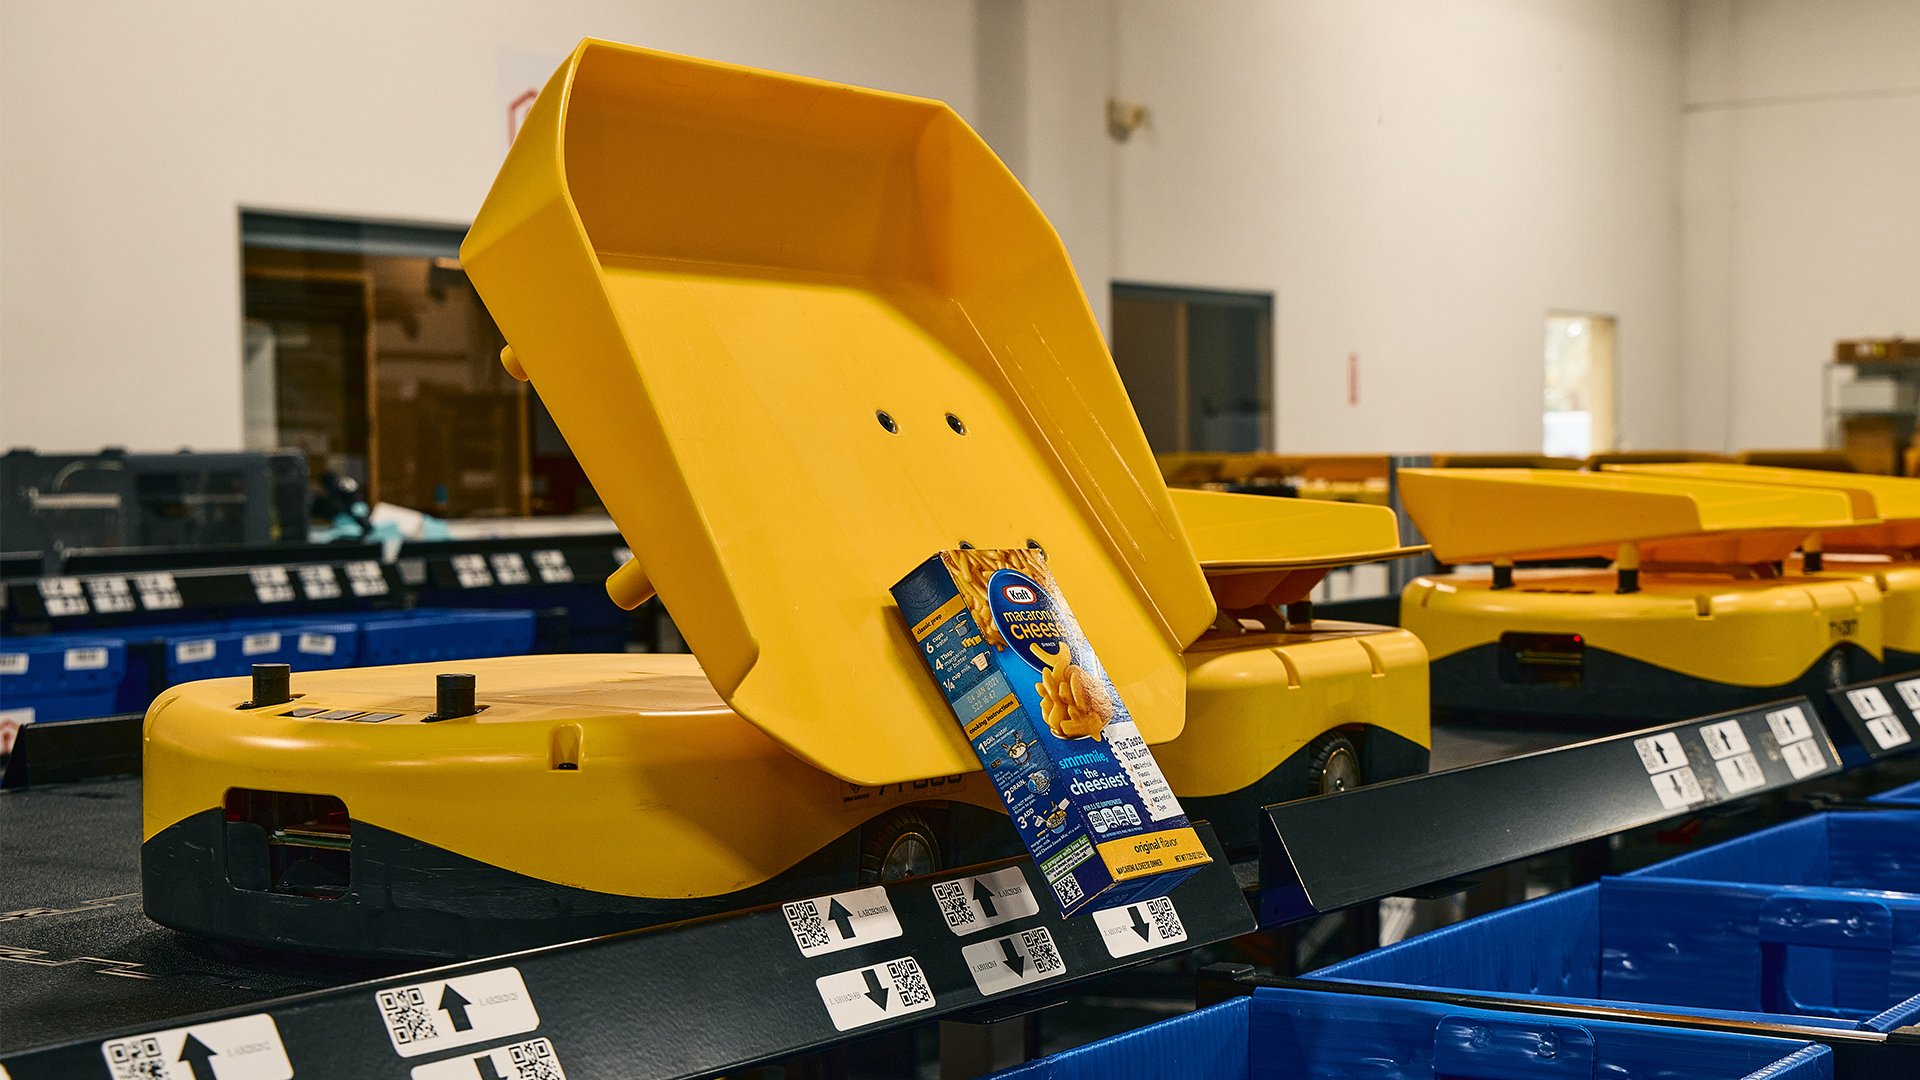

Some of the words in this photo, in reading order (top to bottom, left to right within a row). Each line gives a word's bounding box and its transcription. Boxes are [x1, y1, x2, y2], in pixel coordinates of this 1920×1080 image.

[1009, 589, 1031, 600] Kraft
[1002, 610, 1052, 622] macaroni
[917, 622, 932, 635] classic
[931, 613, 942, 626] prep
[932, 632, 944, 642] cups
[926, 642, 934, 654] 6
[936, 658, 944, 670] 4
[970, 718, 988, 734] cooking
[986, 700, 1014, 720] instructions
[978, 743, 988, 754] 1
[1114, 740, 1129, 750] The
[1126, 736, 1144, 748] Taste
[1058, 750, 1110, 770] smmmile,
[1084, 768, 1100, 779] the
[1070, 772, 1129, 796] cheesiest
[1004, 790, 1014, 804] 2
[1024, 808, 1034, 818] ADD
[1018, 816, 1028, 829] 3
[1134, 838, 1160, 854] original
[1160, 836, 1178, 850] flavor
